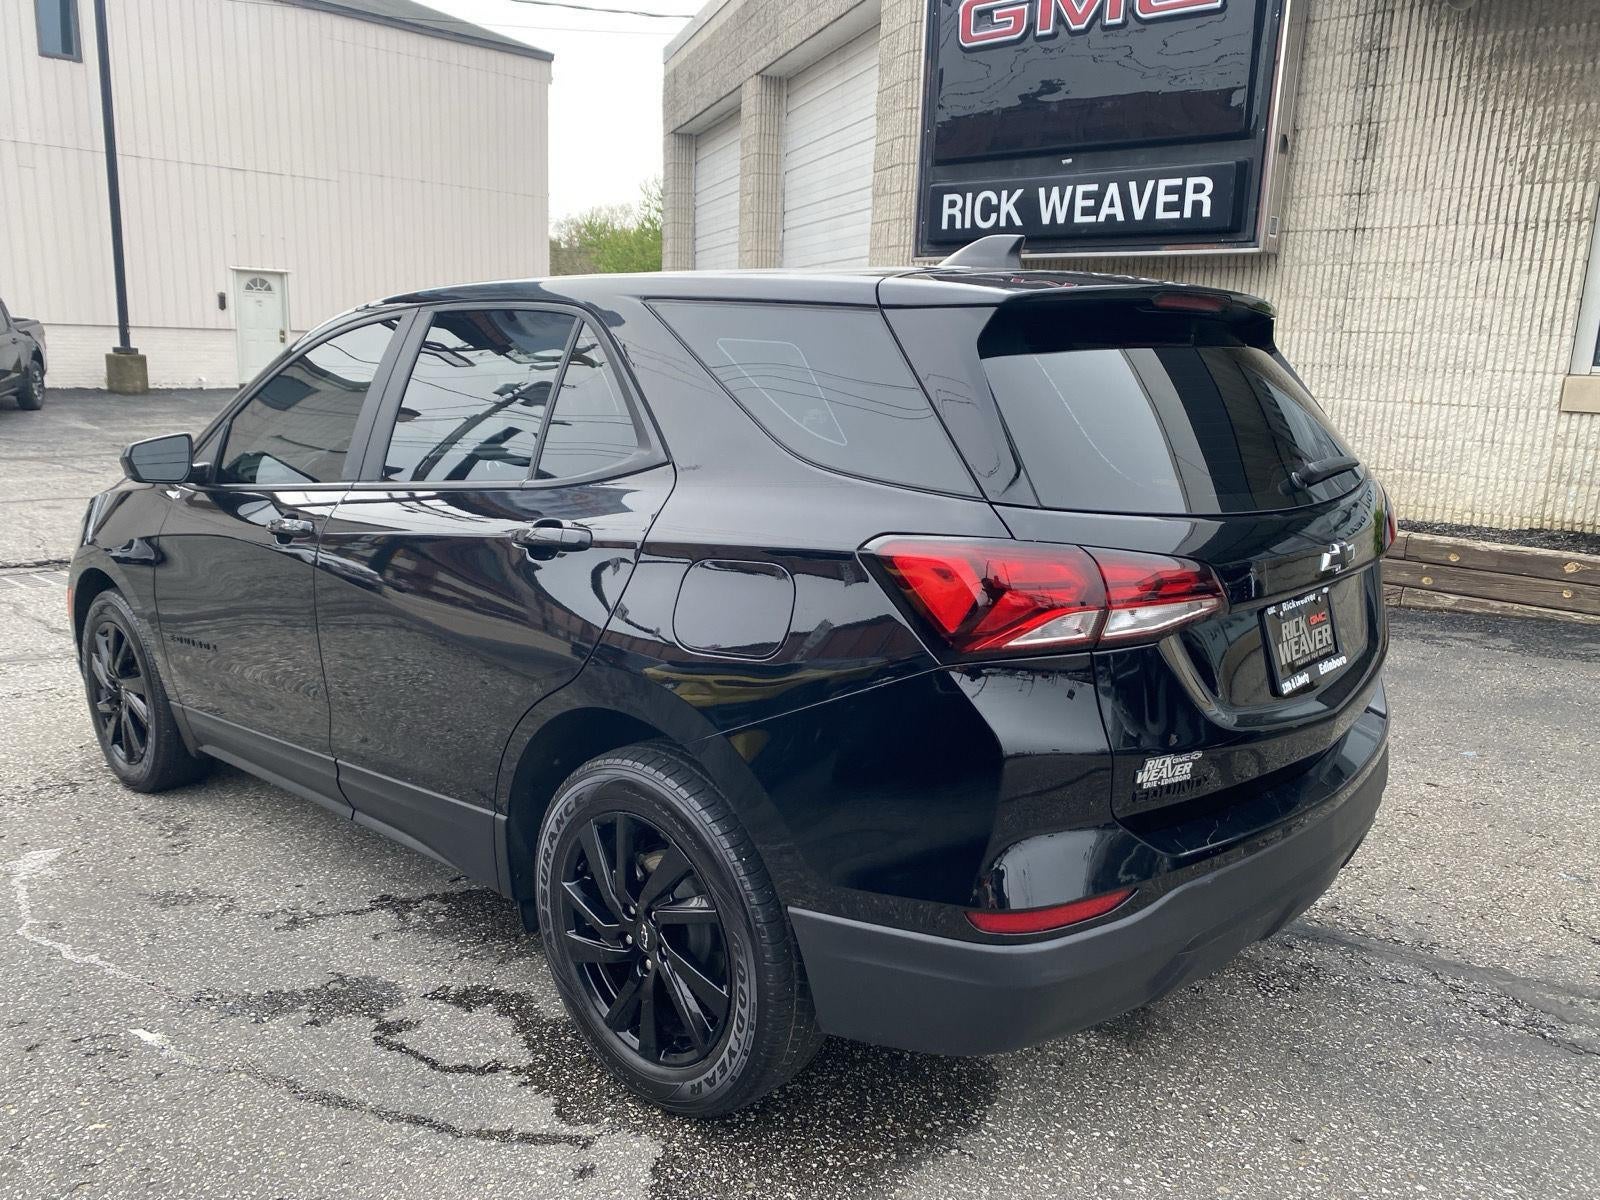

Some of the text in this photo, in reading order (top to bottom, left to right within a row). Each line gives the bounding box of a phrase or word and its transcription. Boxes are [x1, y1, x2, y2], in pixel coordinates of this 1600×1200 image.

[941, 176, 1214, 230] RICK WEAVER
[1281, 614, 1309, 641] RICK
[1309, 611, 1326, 625] GMC
[1278, 624, 1332, 665] WEAVER
[1318, 655, 1347, 675] Edinboro
[1136, 762, 1193, 783] WEAVER
[1145, 756, 1174, 771] RICK
[1143, 780, 1158, 789] ERIE
[689, 931, 749, 1096] GOODYEAR
